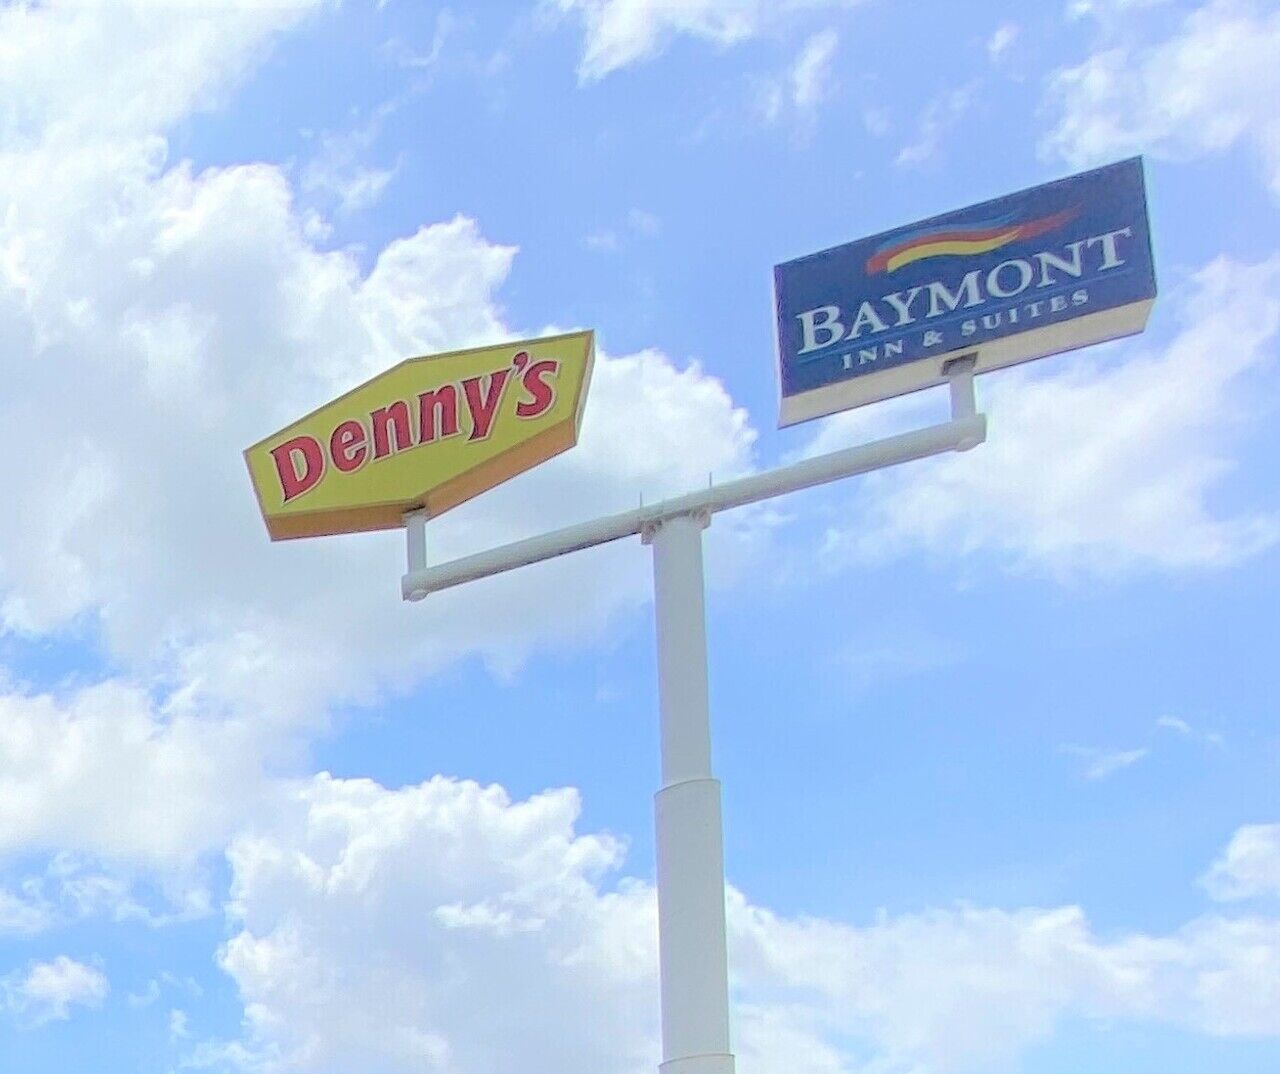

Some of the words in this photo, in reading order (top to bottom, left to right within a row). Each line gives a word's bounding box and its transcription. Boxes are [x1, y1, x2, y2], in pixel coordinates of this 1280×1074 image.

[796, 225, 1134, 355] BAYMONT
[842, 339, 904, 370] INN
[922, 329, 943, 348] &
[960, 288, 1090, 337] SUITES
[269, 350, 561, 508] Denny's
